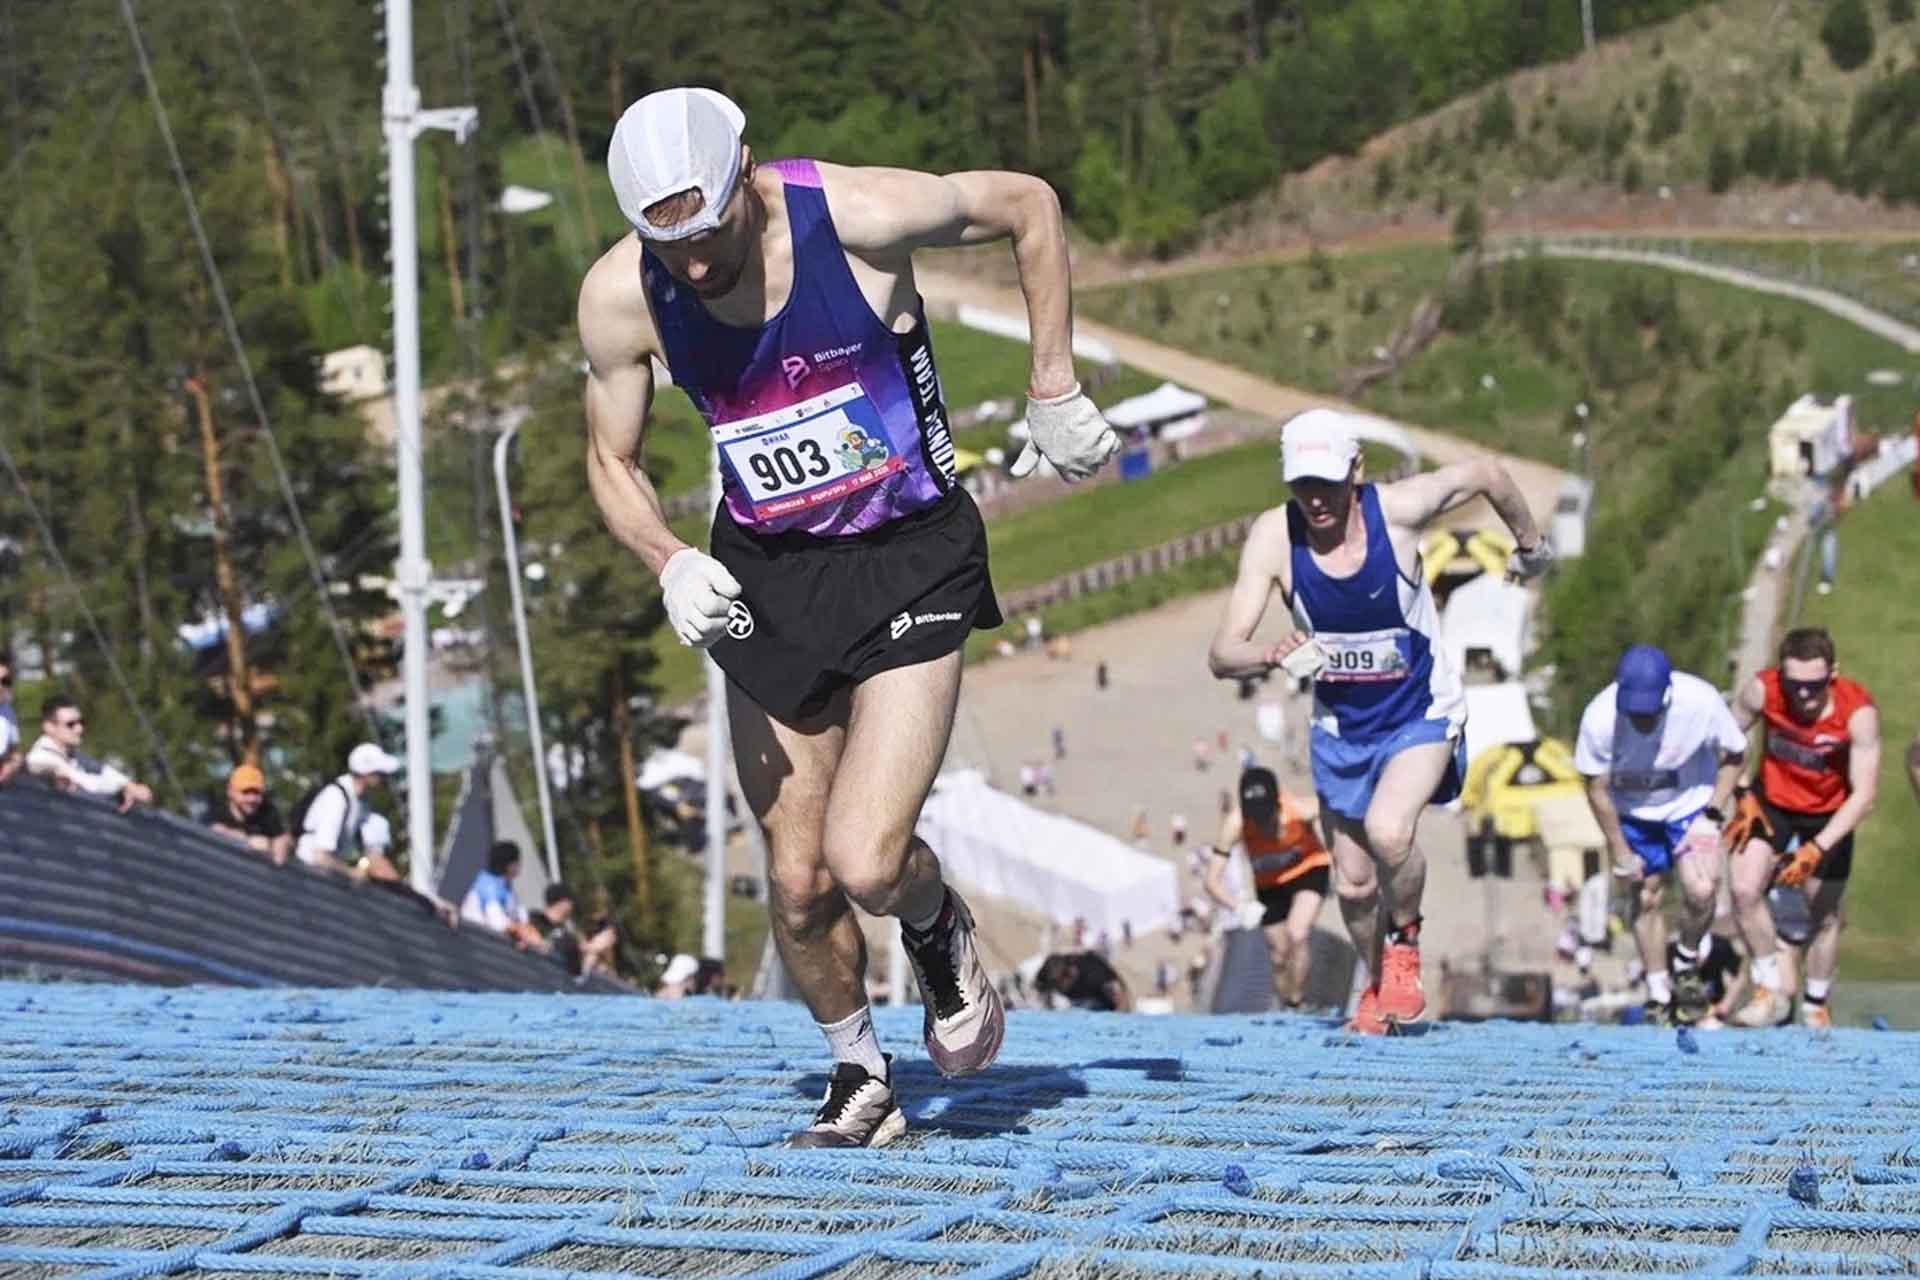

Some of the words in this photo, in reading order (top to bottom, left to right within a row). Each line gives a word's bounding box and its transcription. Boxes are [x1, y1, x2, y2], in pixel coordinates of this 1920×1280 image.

[910, 345, 936, 407] TEAM
[749, 439, 831, 491] 903
[1329, 650, 1373, 669] 909
